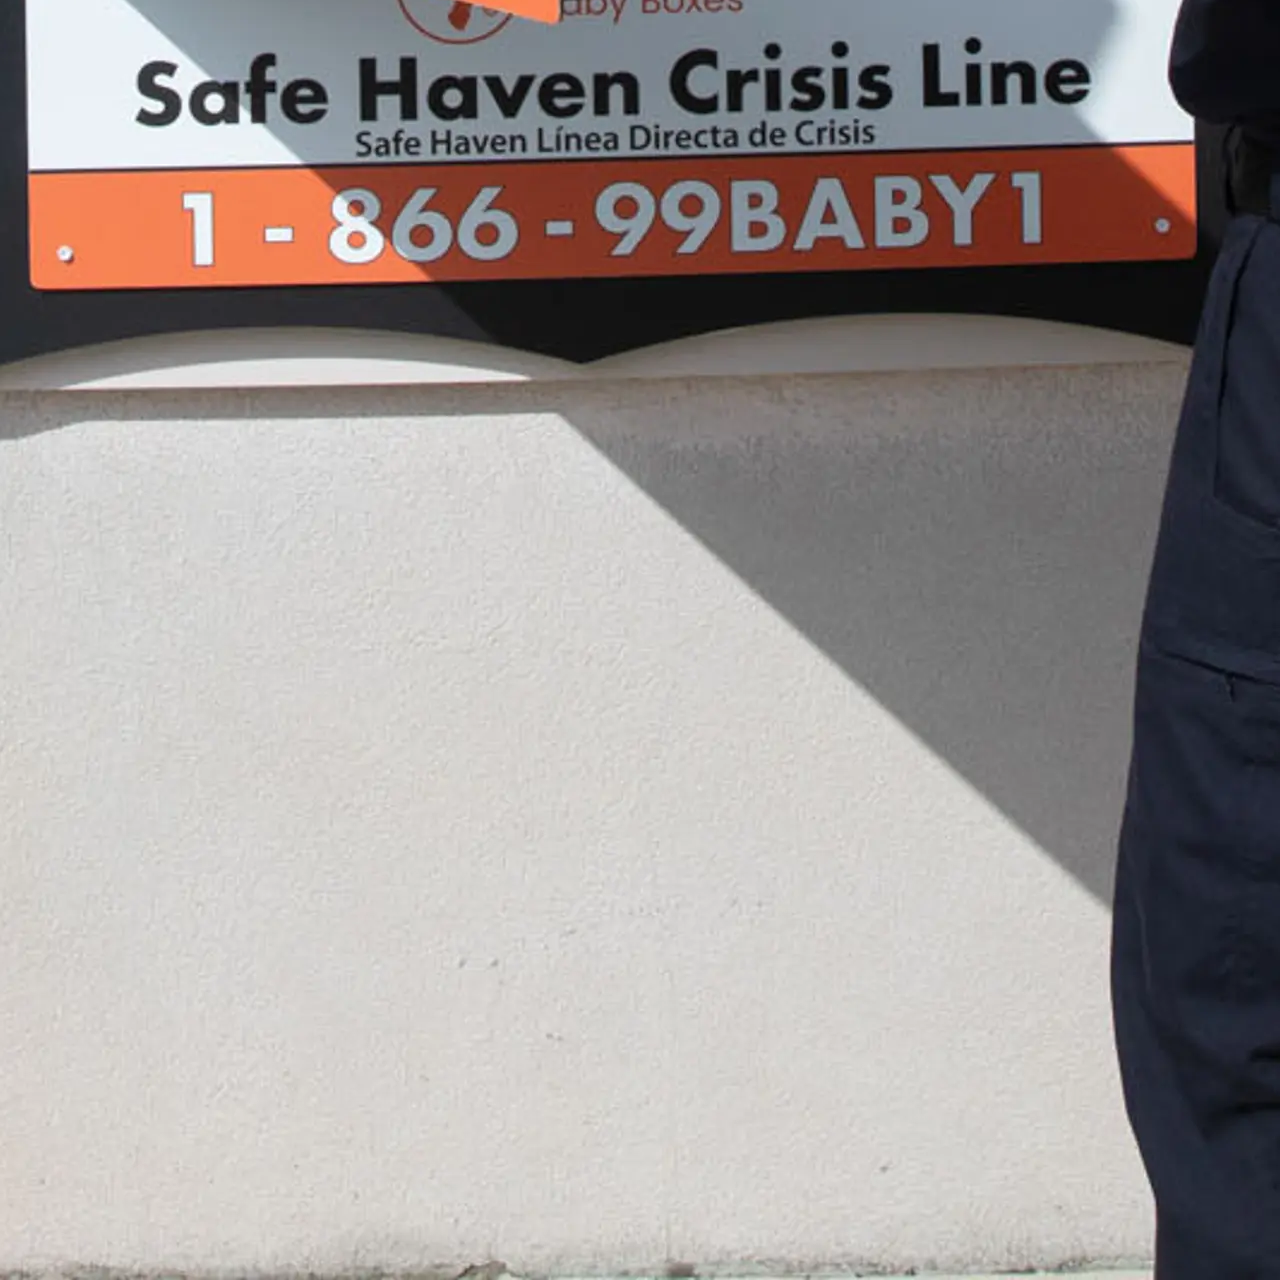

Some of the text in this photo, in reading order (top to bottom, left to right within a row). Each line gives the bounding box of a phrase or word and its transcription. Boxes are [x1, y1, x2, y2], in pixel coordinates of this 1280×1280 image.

[135, 37, 1091, 128] Safe Haven Crisis Line
[356, 119, 875, 157] Safe Haven Línea Directa de Crisis
[183, 192, 213, 266] 1
[329, 187, 518, 265] 866
[595, 172, 1041, 255] 99BABY1
